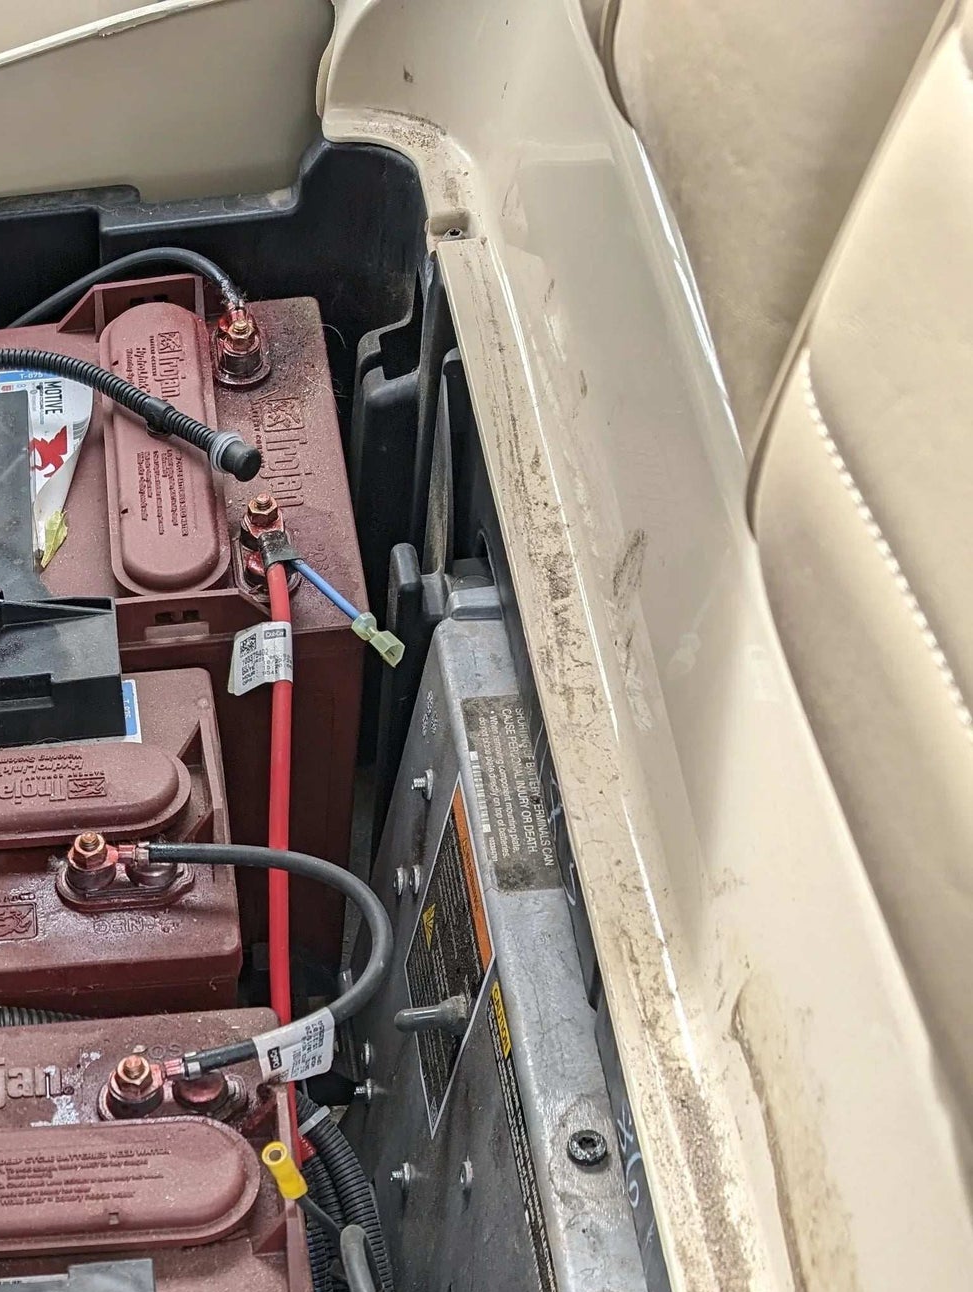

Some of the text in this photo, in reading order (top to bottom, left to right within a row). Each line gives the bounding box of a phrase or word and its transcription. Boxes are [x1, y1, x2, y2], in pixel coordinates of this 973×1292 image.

[156, 354, 182, 400] Trojan
[44, 380, 63, 415] MOTIVE
[265, 430, 308, 509] Trojan
[489, 715, 499, 734] When
[501, 708, 515, 734] CAUSE
[490, 735, 504, 764] removing
[486, 772, 500, 797] directly
[496, 764, 511, 801] component
[515, 779, 529, 808] INJURY
[492, 797, 501, 806] on
[493, 806, 504, 819] top
[521, 809, 532, 823] OR
[496, 818, 506, 827] of
[503, 801, 517, 833] mounting
[497, 827, 511, 858] batteries.
[523, 823, 538, 854] DEATH.
[541, 846, 554, 866] CAN
[493, 988, 511, 1052] CAUTION
